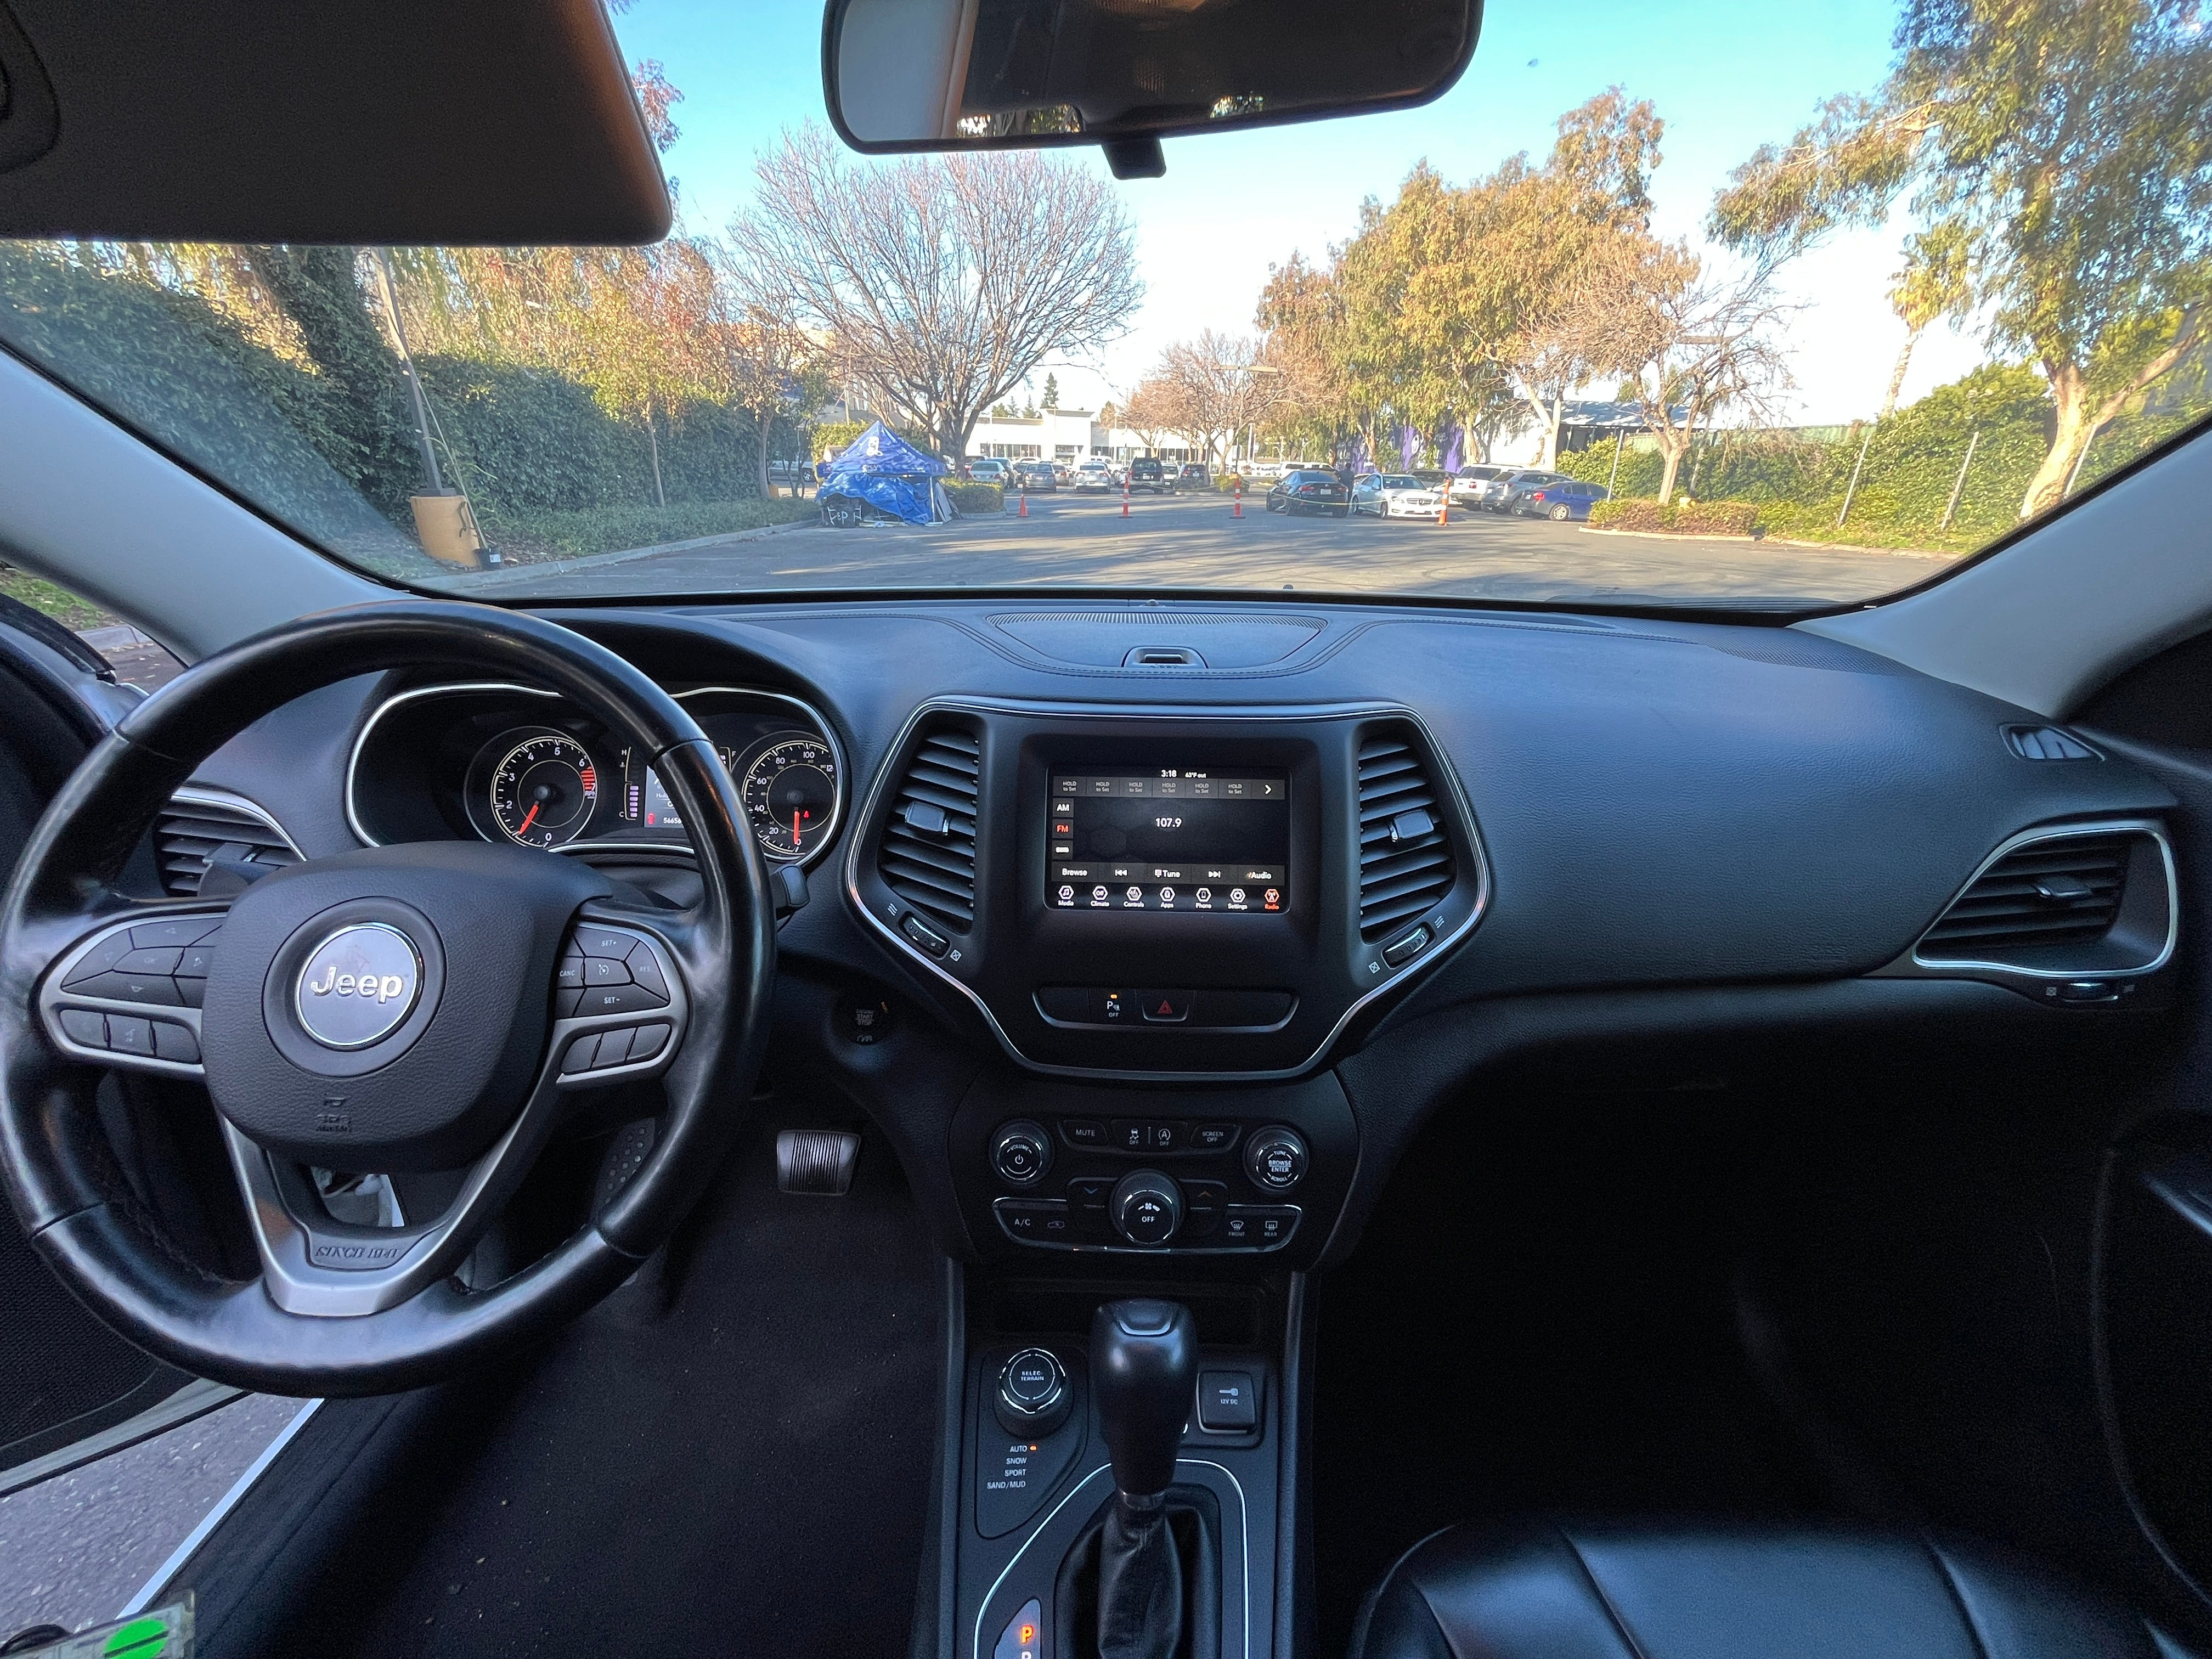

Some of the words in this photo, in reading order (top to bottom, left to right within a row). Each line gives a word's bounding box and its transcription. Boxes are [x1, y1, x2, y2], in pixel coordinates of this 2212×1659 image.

[528, 753, 534, 761] 4
[579, 758, 585, 766] 6
[509, 773, 515, 781] 3
[1161, 769, 1177, 778] 3:18
[590, 782, 596, 791] 7
[1155, 818, 1182, 827] 107.9
[545, 833, 552, 841] 0
[1062, 868, 1088, 877] Browse
[1162, 870, 1181, 878] Tune
[1251, 871, 1272, 879] Audio
[310, 966, 404, 1004] Jeep
[1014, 1218, 1031, 1226] A/C
[1005, 1469, 1026, 1477] SPORT
[987, 1481, 1026, 1490] SAND/MUD
[1022, 1626, 1034, 1643] P
